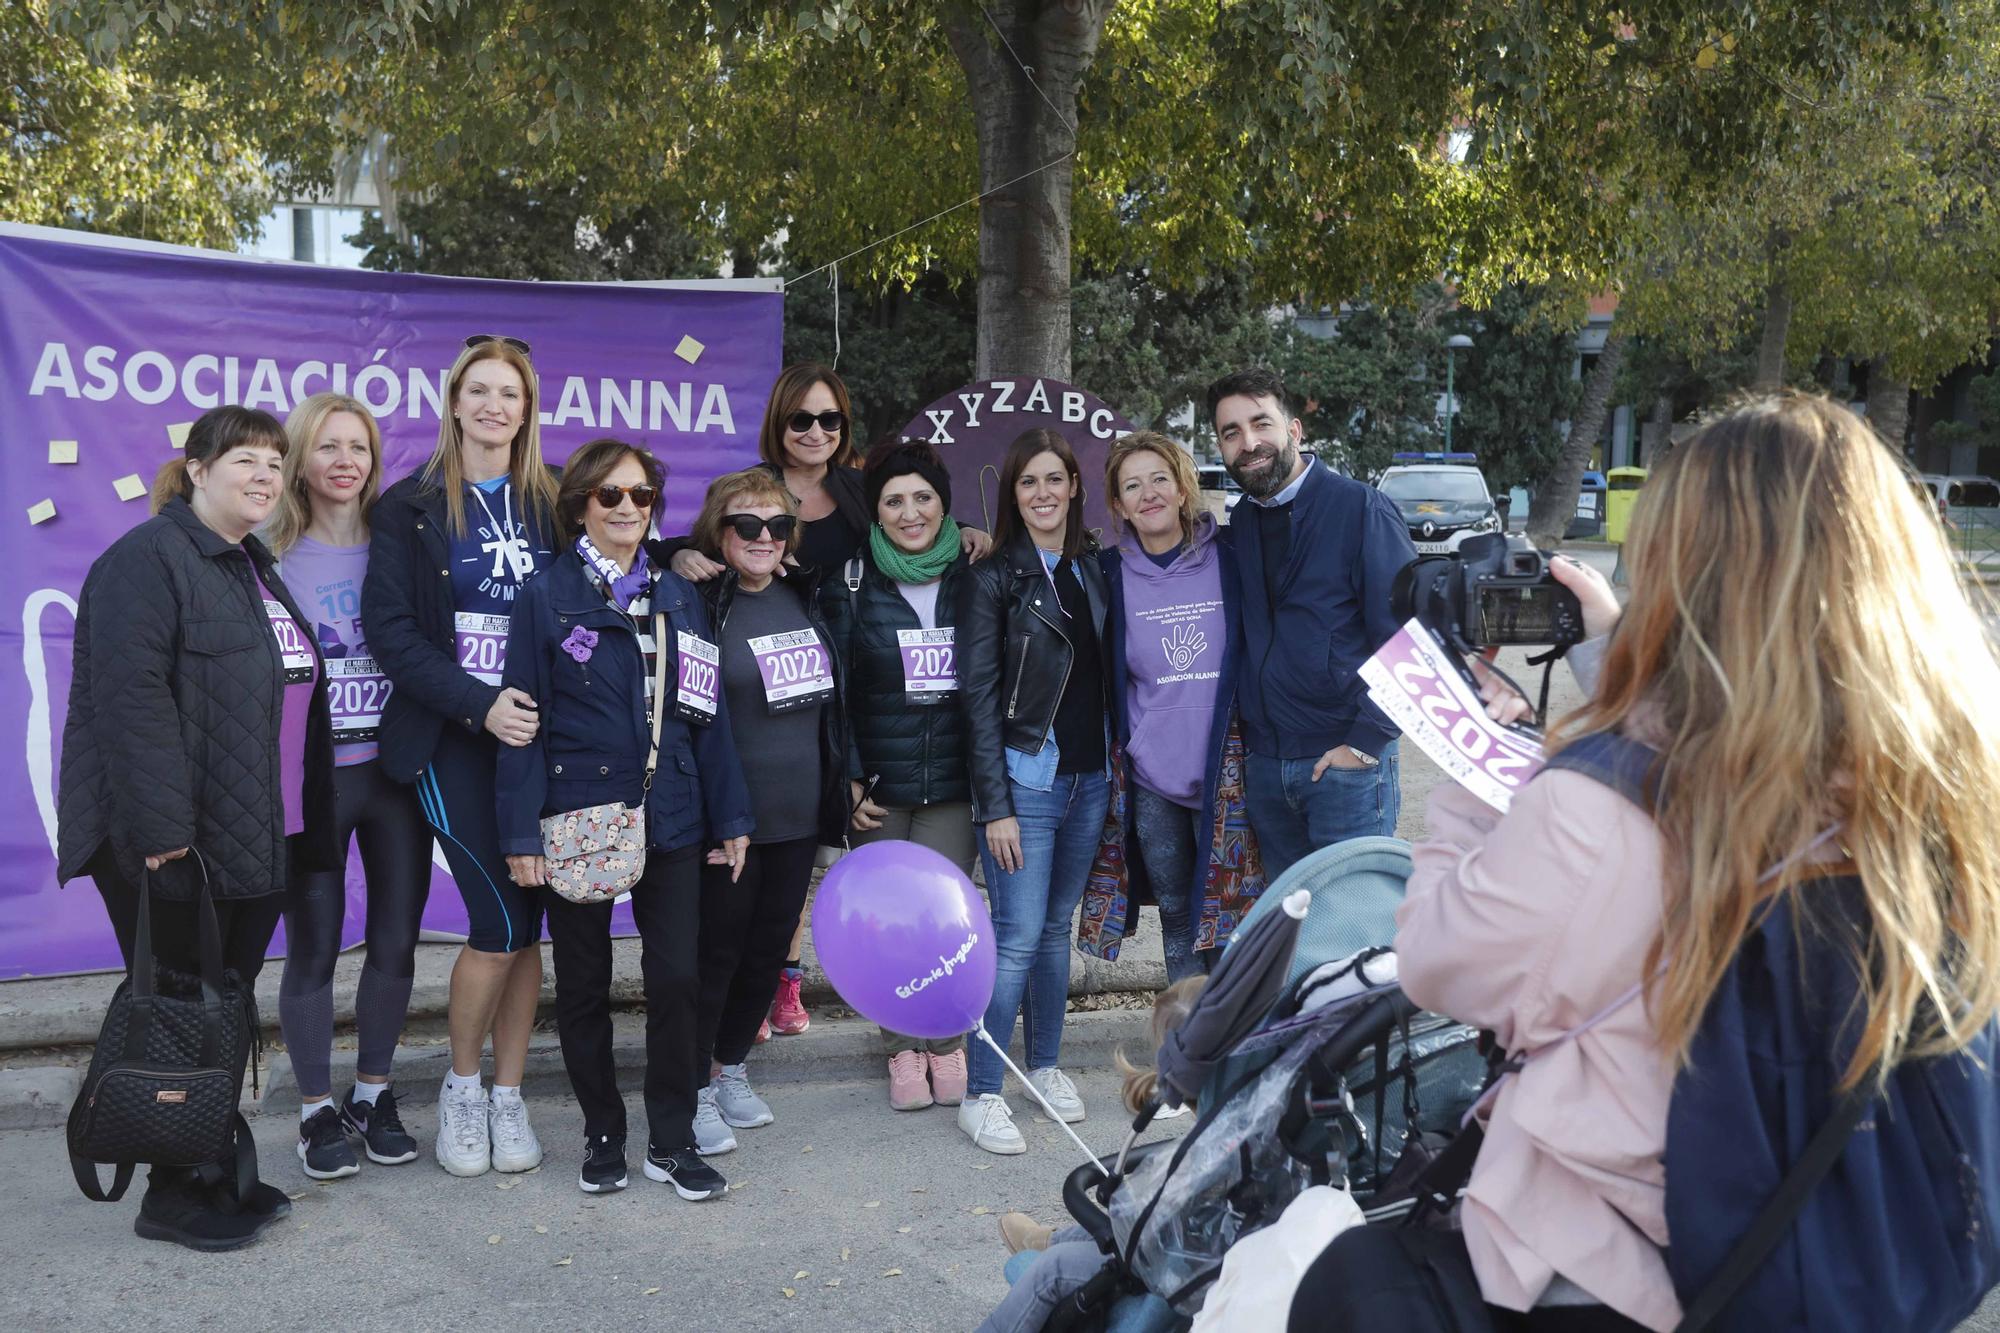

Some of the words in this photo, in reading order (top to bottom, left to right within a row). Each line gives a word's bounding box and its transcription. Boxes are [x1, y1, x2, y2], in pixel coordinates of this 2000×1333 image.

[29, 342, 450, 419] ASOCIACIÓN
[482, 538, 534, 577] 76
[316, 579, 353, 594] Carrera
[319, 589, 360, 619] 10
[271, 621, 305, 653] 22
[461, 636, 507, 671] 20
[683, 656, 716, 698] 2022
[765, 648, 825, 686] 2022
[910, 647, 957, 677] 202
[1156, 672, 1194, 685] ASOCIACIÓN
[327, 679, 394, 713] 2022
[1393, 647, 1531, 786] 2022
[910, 967, 944, 991] Corte
[939, 932, 978, 976] Inglés
